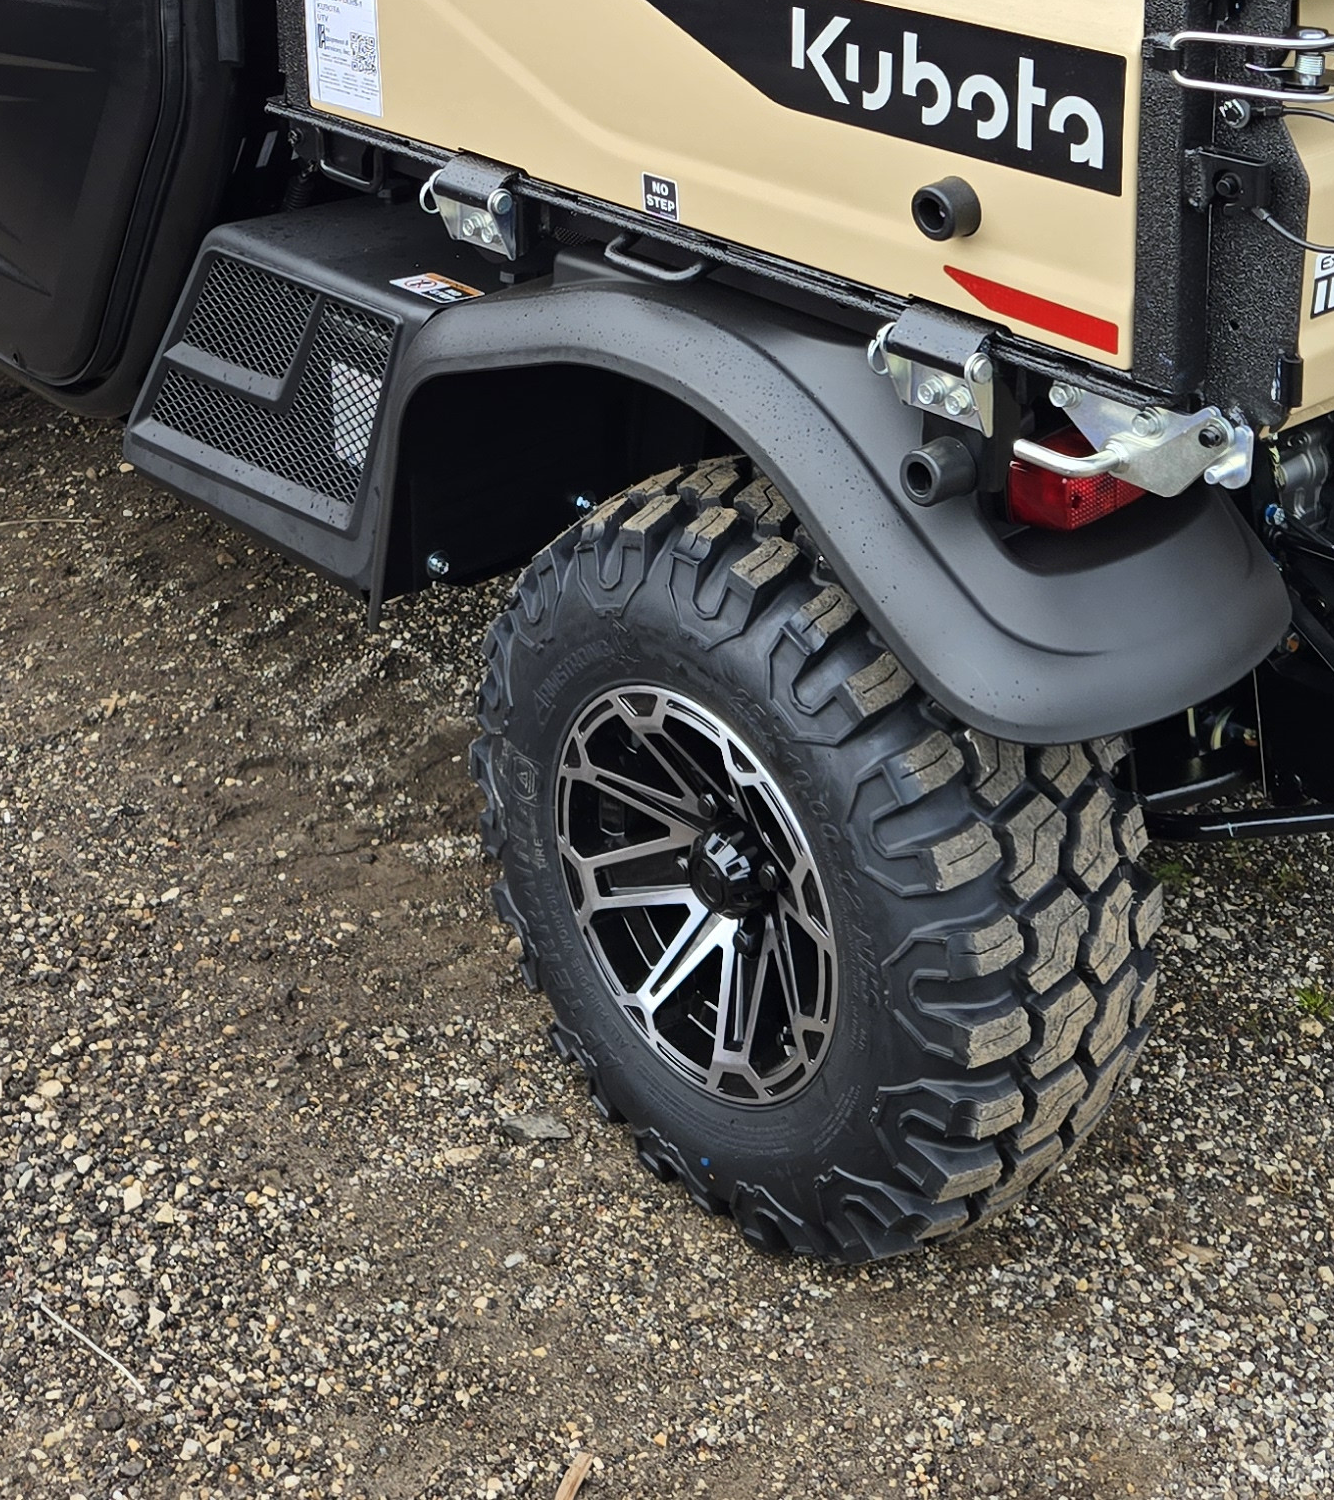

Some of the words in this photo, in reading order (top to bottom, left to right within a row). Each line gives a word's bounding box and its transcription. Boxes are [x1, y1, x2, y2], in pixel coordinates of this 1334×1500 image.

[790, 5, 1106, 171] Kubota
[652, 181, 669, 196] NO
[646, 193, 676, 212] STEP
